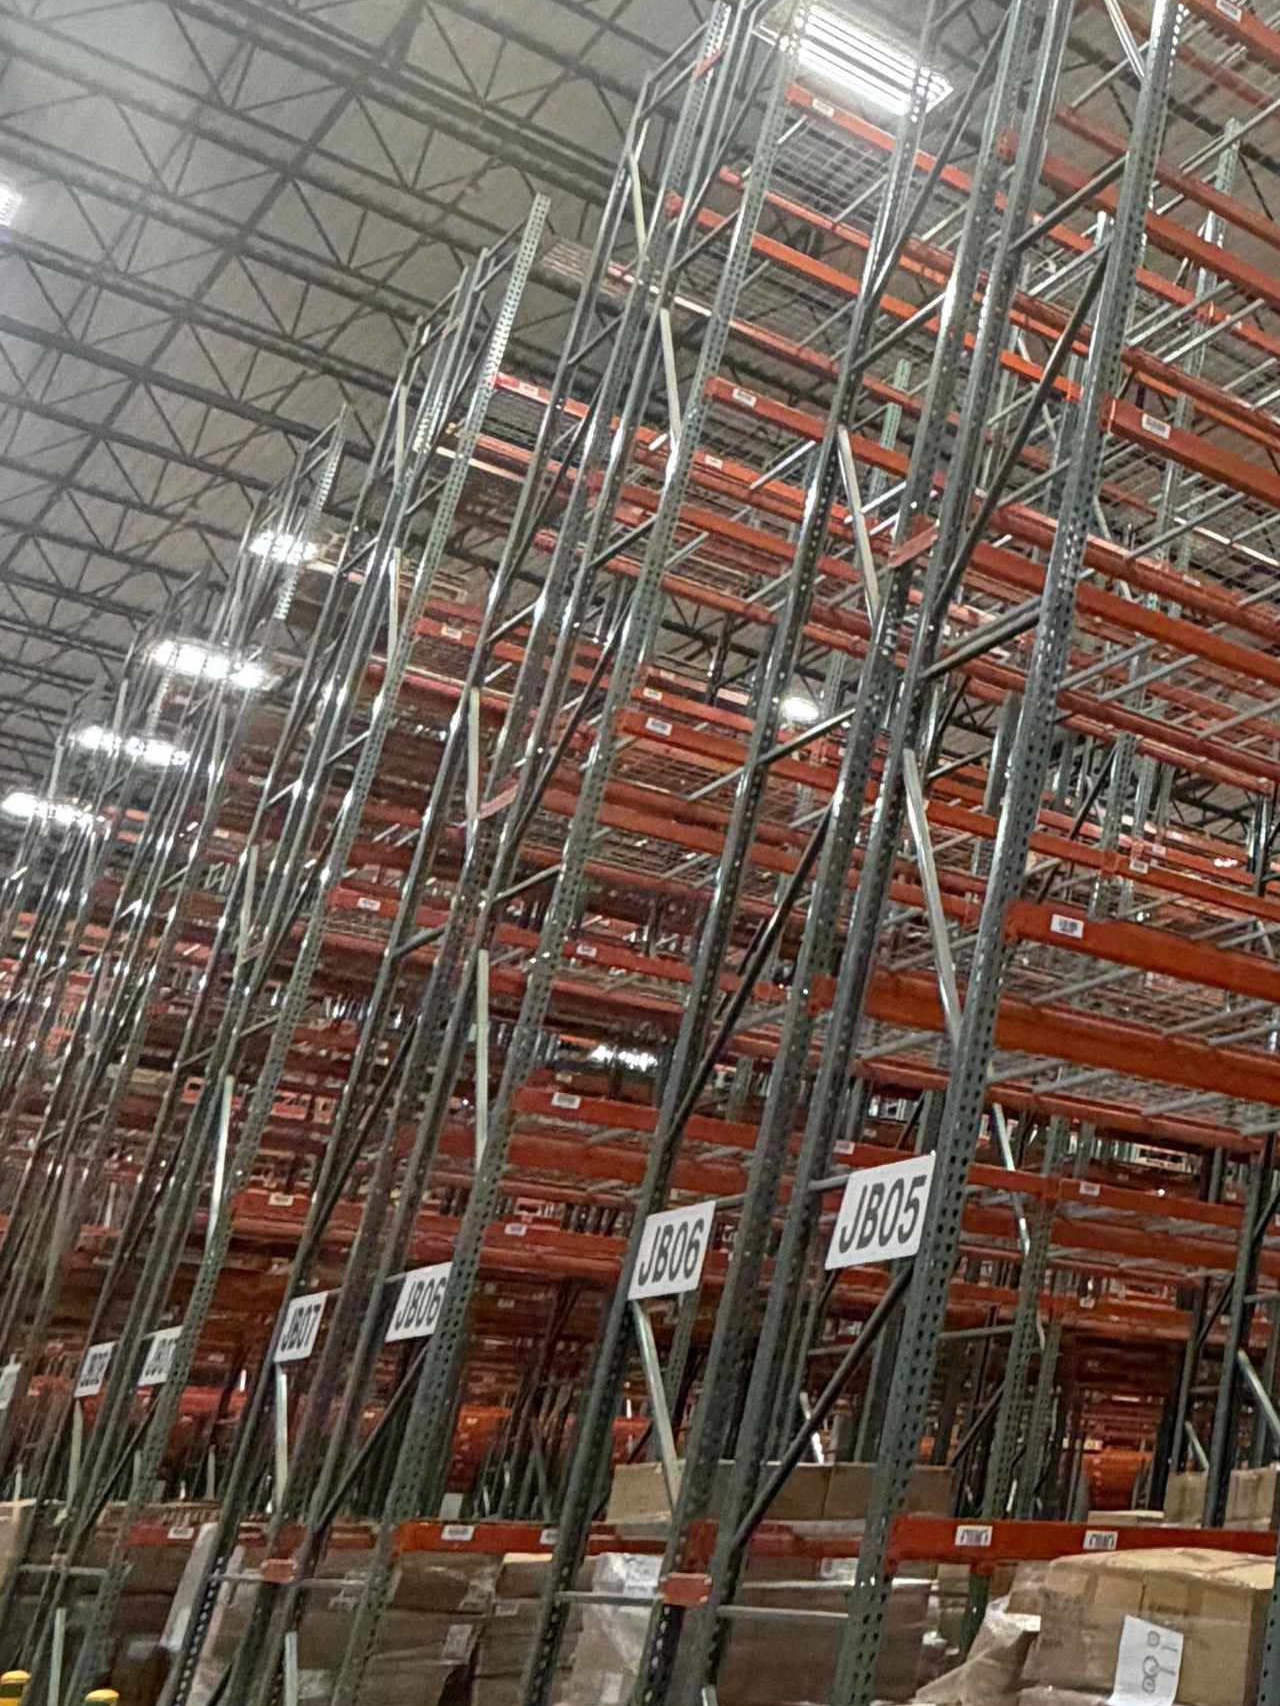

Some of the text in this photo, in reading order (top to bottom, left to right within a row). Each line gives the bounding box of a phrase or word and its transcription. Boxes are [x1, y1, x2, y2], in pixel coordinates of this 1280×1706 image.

[839, 1175, 927, 1253] JB05
[638, 1218, 705, 1286] JB06
[280, 1303, 322, 1353] JB07
[395, 1276, 447, 1331] JB06
